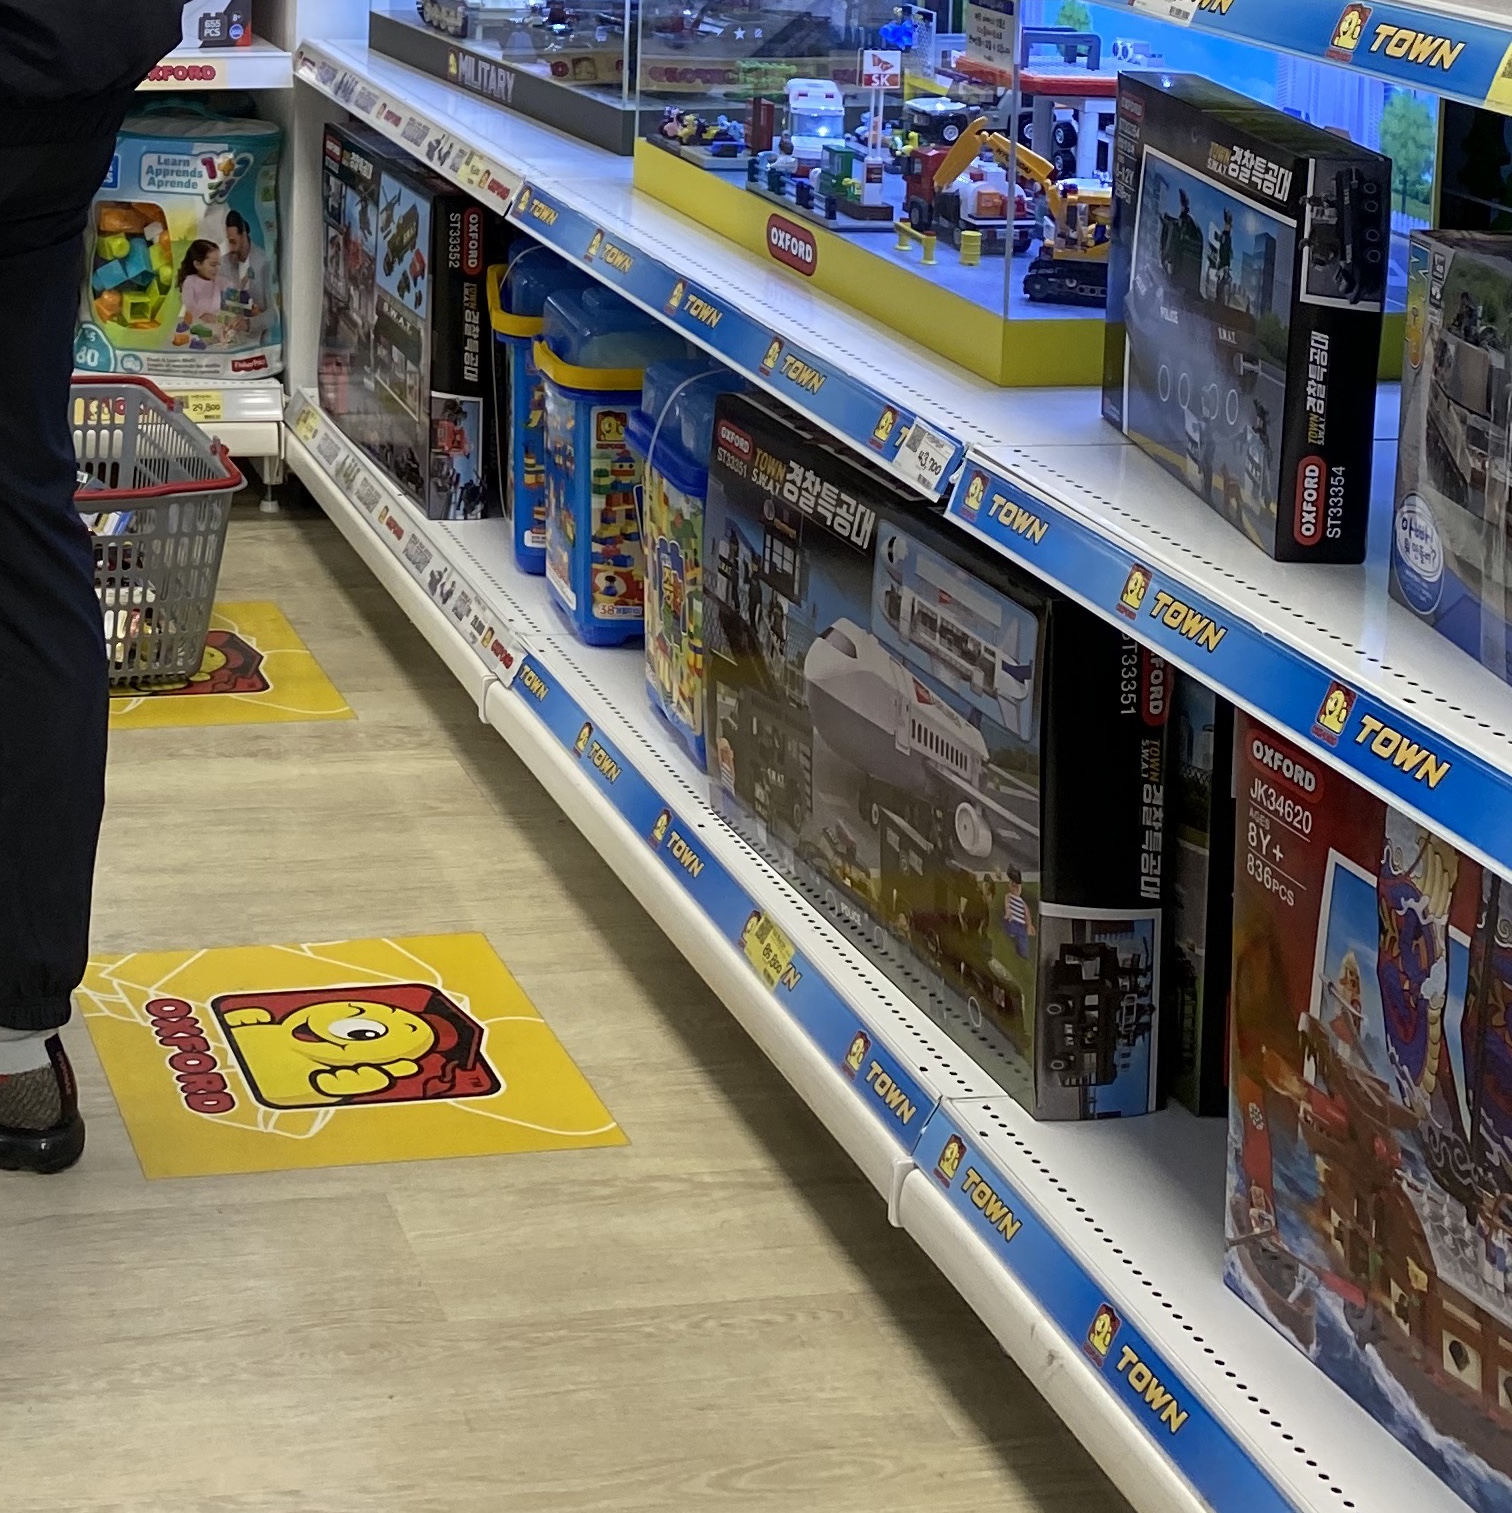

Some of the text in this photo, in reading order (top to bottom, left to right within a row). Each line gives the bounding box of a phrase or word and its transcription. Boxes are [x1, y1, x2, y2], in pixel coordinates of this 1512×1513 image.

[205, 20, 221, 29] 655
[205, 29, 221, 38] PCS
[1371, 24, 1469, 71] TOWN
[458, 52, 515, 102] MILITARY
[870, 73, 891, 86] SK
[146, 166, 203, 180] Apprends
[147, 177, 199, 190] Aprende
[157, 155, 191, 167] Learn
[1228, 144, 1293, 202] 경찰특공대
[529, 198, 559, 226] TOWN
[448, 212, 462, 269] ST33352
[466, 213, 479, 269] OXFORD
[600, 240, 635, 274] TOWN
[770, 225, 814, 265] OXFORD
[684, 293, 724, 329] TOWN
[781, 354, 828, 394] TOWN
[1306, 331, 1330, 413] 경찰특공대
[192, 401, 220, 413] 29,800
[716, 448, 748, 477] ST33351
[720, 425, 750, 453] OXFORD
[753, 448, 787, 481] TOWN
[782, 459, 876, 551] 경찰특공대
[988, 493, 1048, 548] TOWN
[1300, 463, 1319, 538] OXFORD
[1326, 466, 1346, 538] ST33354
[1149, 589, 1228, 654] TOWN
[519, 664, 549, 702] TOWN
[589, 740, 621, 785] TOWN
[1252, 738, 1317, 792] OXFORD
[1355, 714, 1451, 791] TOWN
[1248, 806, 1271, 831] AGES
[1249, 776, 1312, 836] JK34620
[667, 830, 705, 880] TOWN
[1140, 783, 1164, 900] 경찰특공대
[1246, 821, 1284, 862] 8Y+
[1246, 853, 1295, 907] 836PCS
[144, 998, 237, 1115] OXFORD
[864, 1059, 918, 1125] TOWN
[959, 1167, 1022, 1243] TOWN
[1115, 1343, 1191, 1436] TOWN
